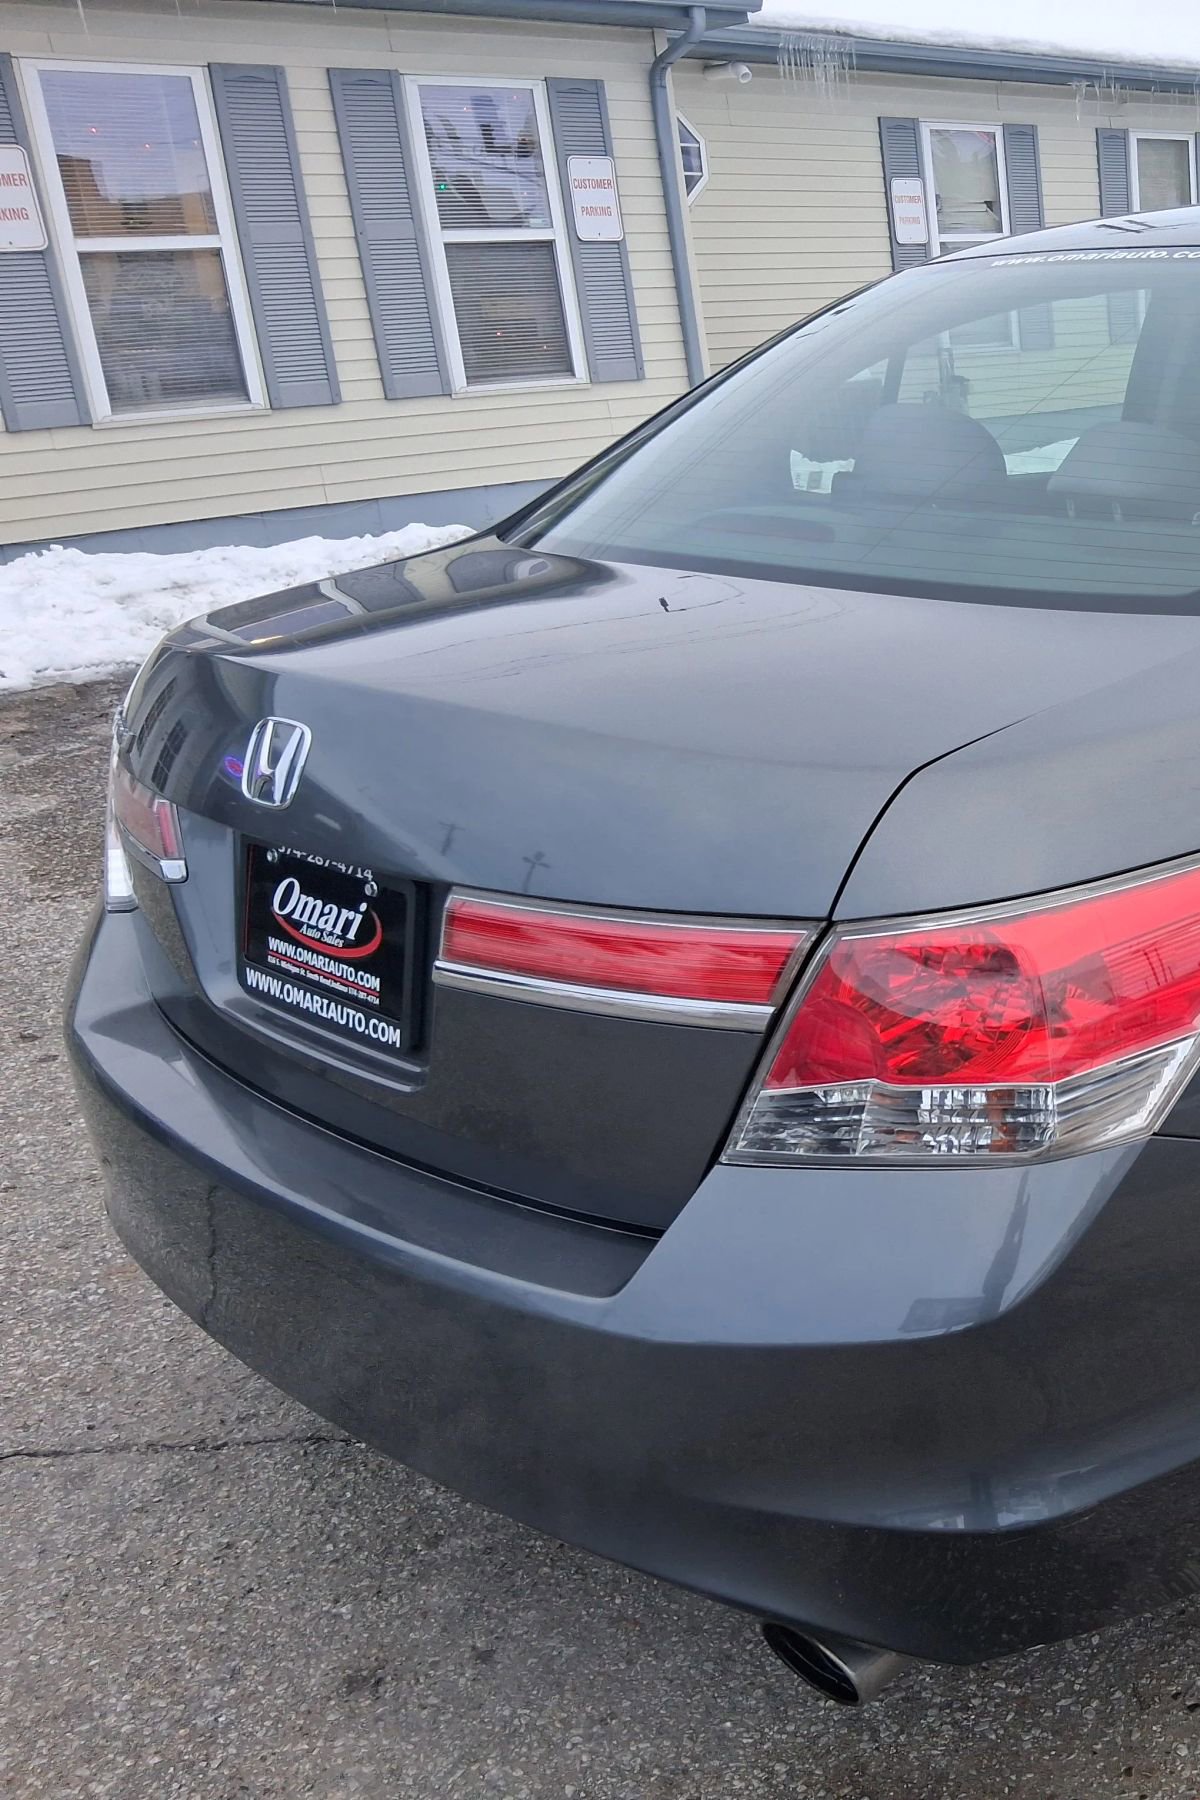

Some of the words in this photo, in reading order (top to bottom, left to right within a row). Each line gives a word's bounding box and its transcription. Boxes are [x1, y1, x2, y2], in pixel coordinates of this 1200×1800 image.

[0, 173, 28, 187] MER
[572, 178, 613, 190] CUSTOMER
[580, 206, 613, 217] PARKING
[272, 877, 368, 940] Omari
[299, 923, 321, 939] Auto
[321, 929, 345, 948] Sales
[268, 936, 380, 991] WWW.OMARIAUTO.COM
[245, 967, 401, 1048] WWW.OMARIAUTO.COM
